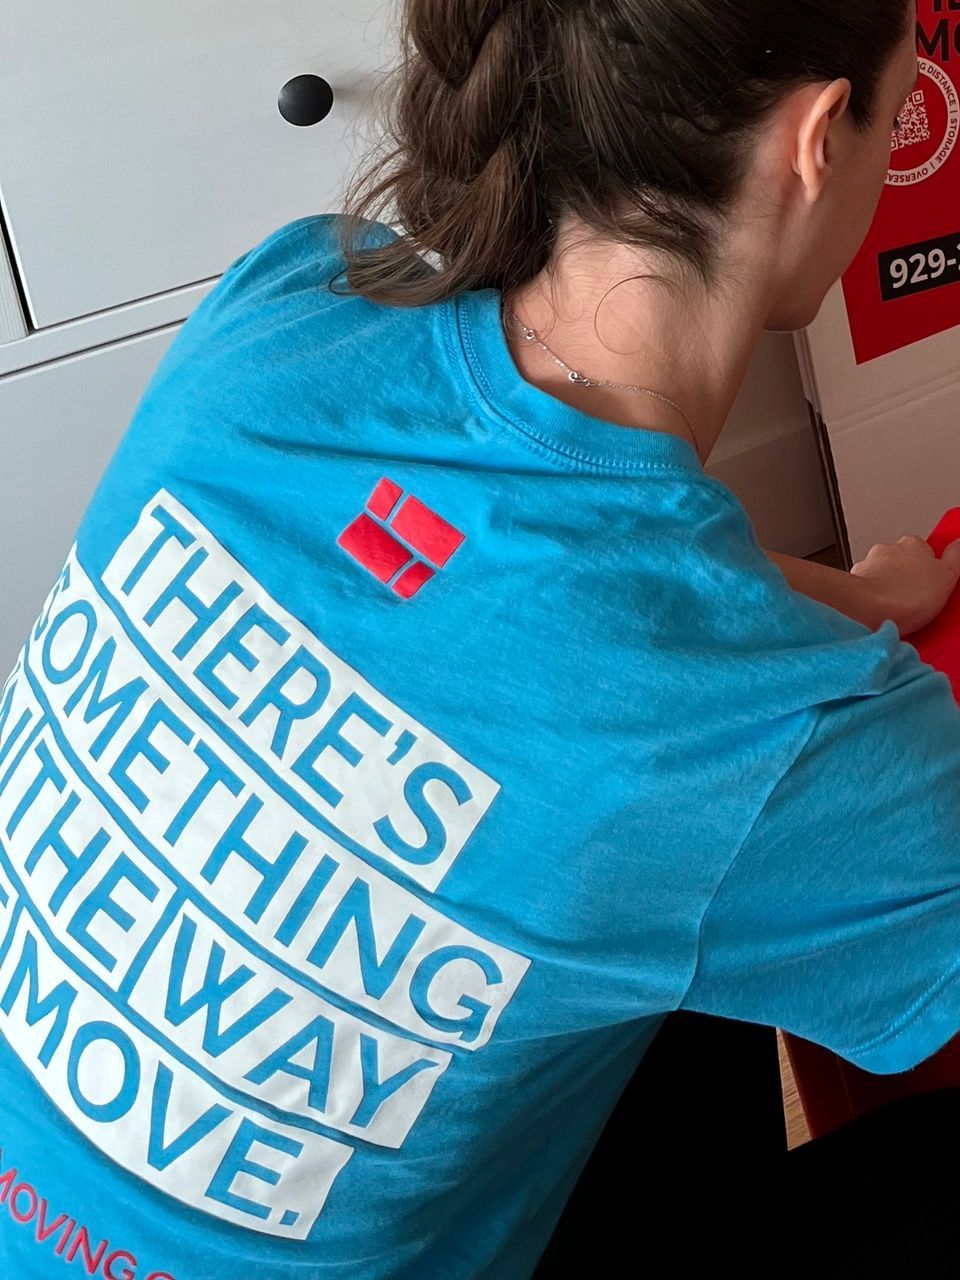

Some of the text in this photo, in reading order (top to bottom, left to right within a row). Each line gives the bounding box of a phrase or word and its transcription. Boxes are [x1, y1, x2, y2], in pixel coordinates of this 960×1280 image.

[887, 167, 929, 183] OVERSEA
[927, 66, 957, 107] DISTANCE
[935, 118, 958, 164] STORAGE
[34, 563, 503, 1042] SOMETHING
[120, 505, 474, 865] THERE'S
[0, 929, 305, 1226] MOVE.
[5, 738, 439, 1129] THE WAY
